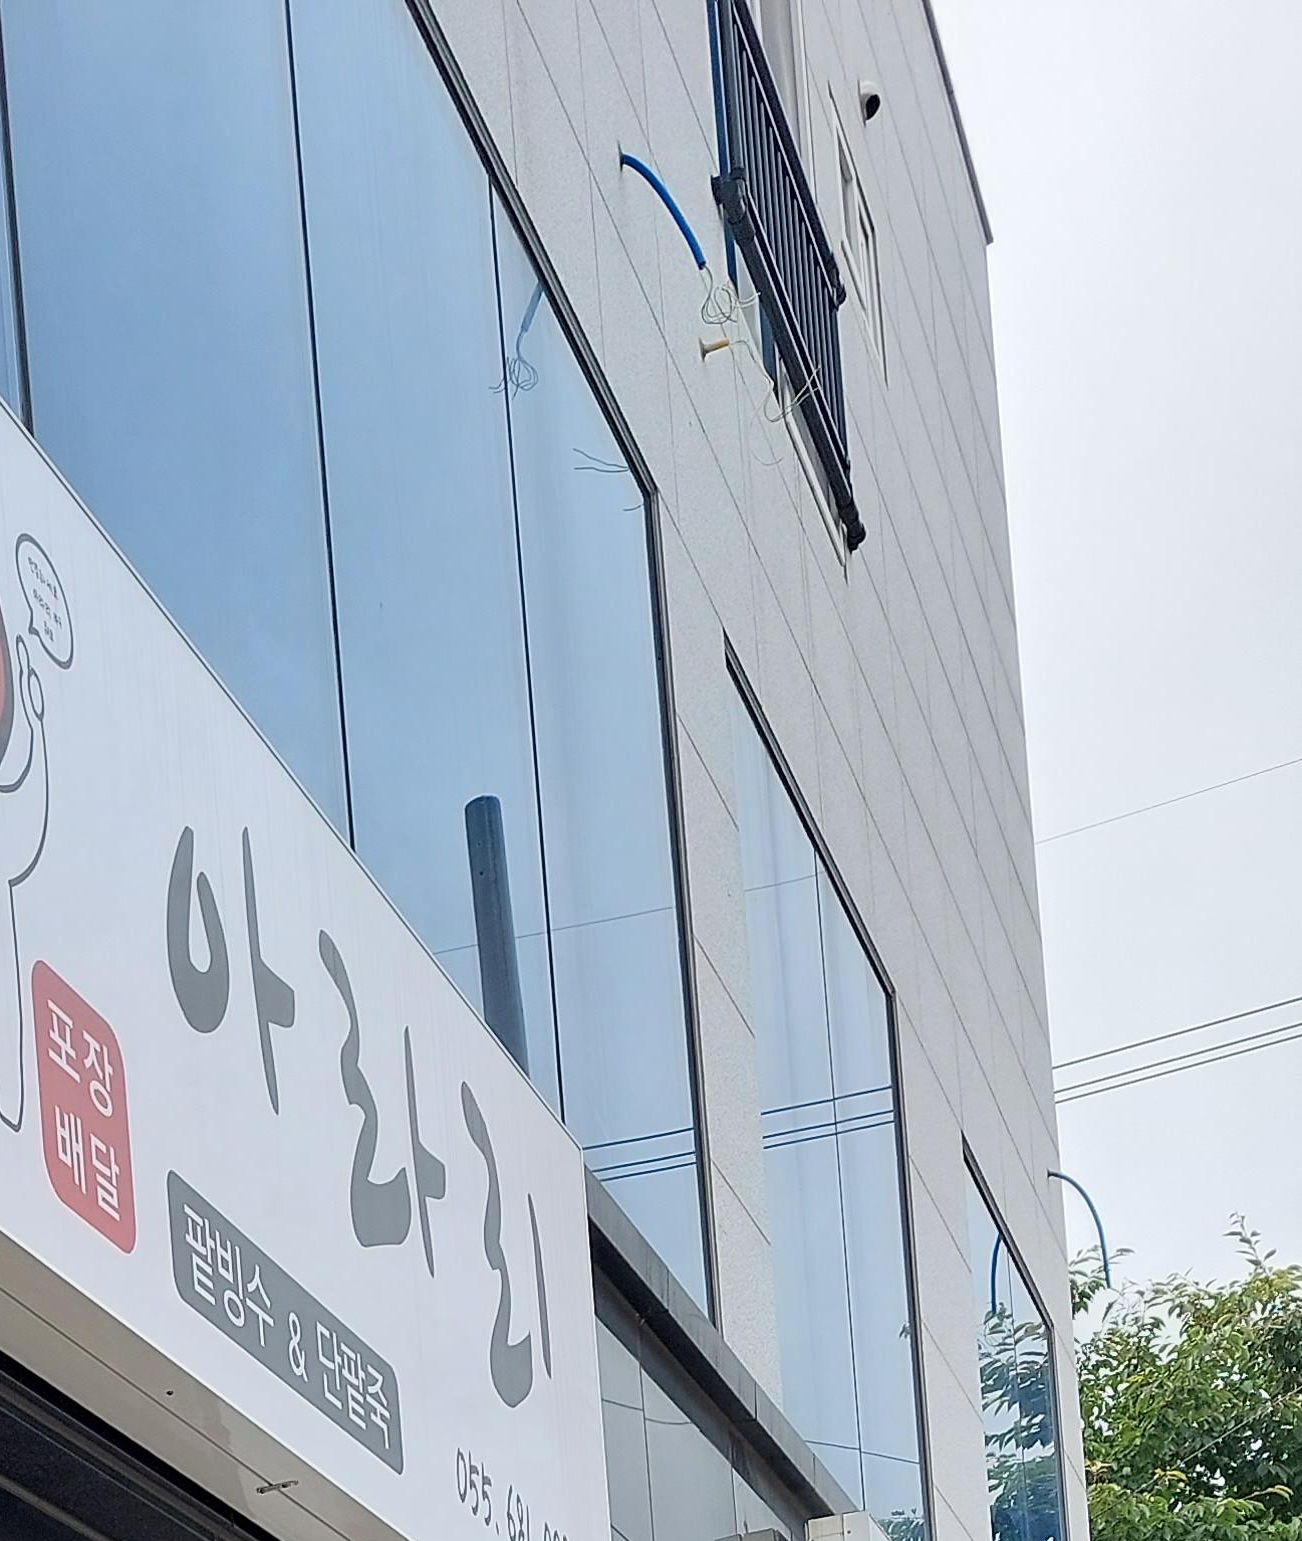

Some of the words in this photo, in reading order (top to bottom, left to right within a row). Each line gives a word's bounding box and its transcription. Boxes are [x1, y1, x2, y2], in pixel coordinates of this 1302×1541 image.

[47, 999, 113, 1117] 포장
[165, 826, 553, 1408] 아라리
[55, 1104, 120, 1222] 배달
[184, 1203, 274, 1347] 팥빙수
[288, 1311, 308, 1382] &
[316, 1321, 390, 1449] 단팥죽
